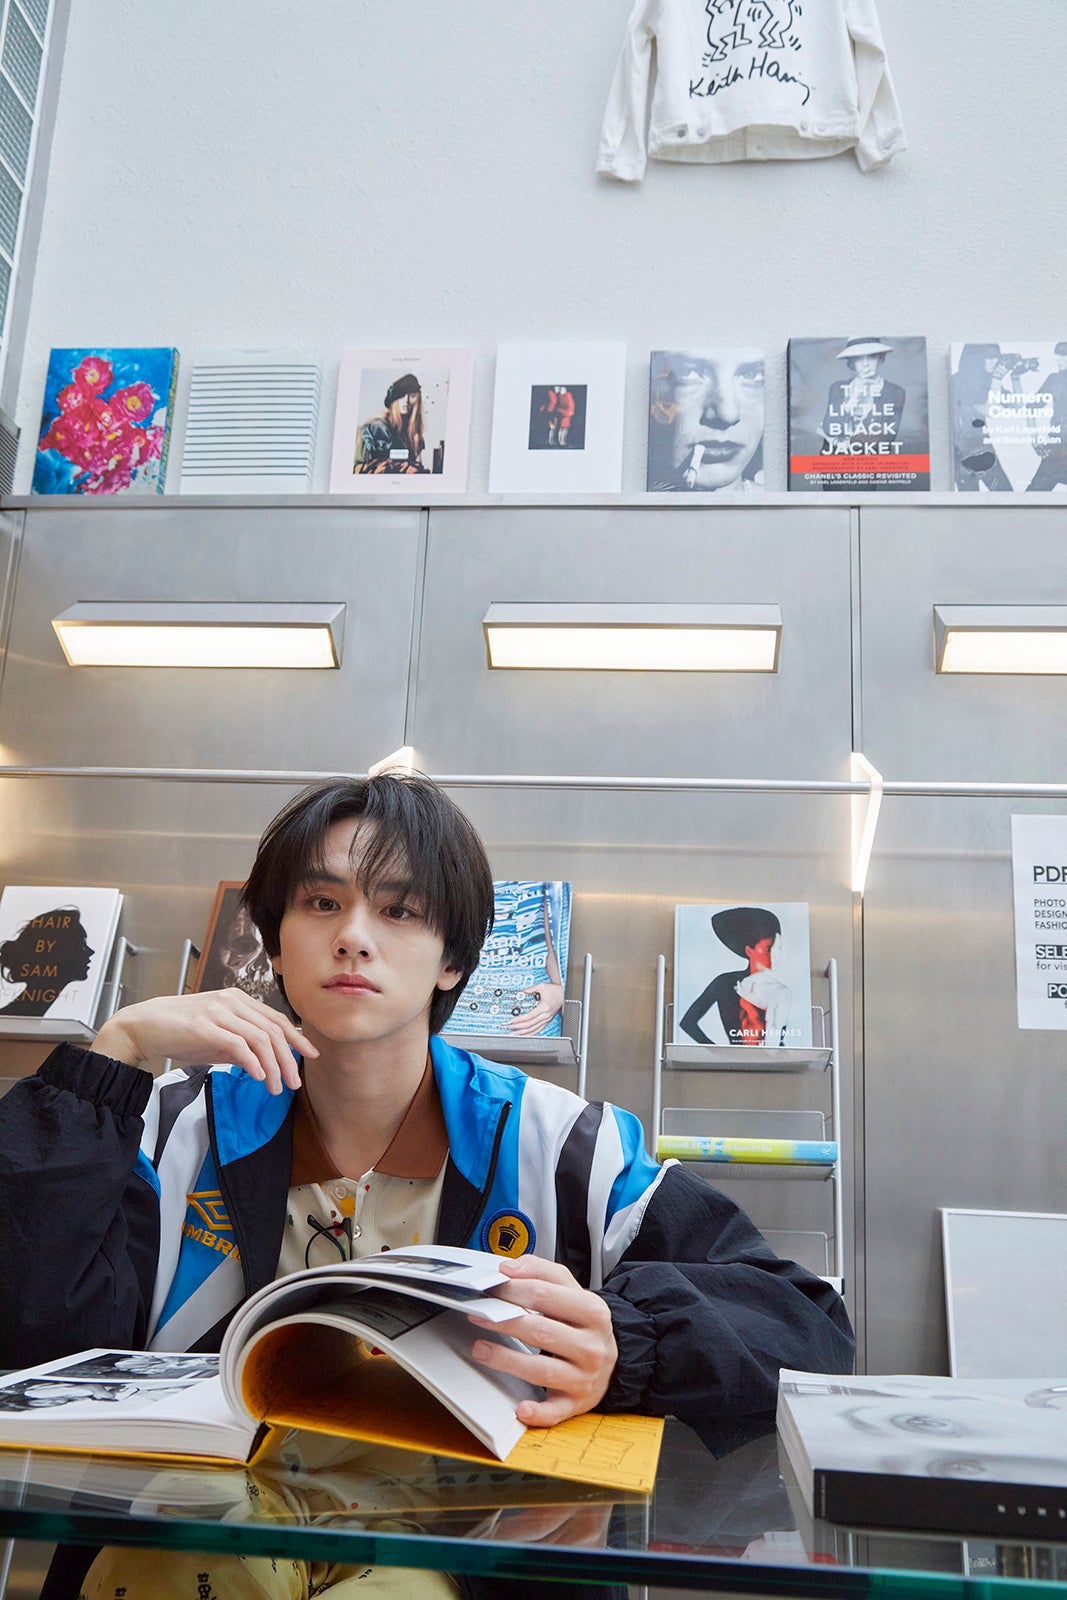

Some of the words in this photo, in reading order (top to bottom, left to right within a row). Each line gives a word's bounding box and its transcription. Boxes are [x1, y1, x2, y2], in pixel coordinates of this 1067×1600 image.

[689, 65, 743, 98] Keith
[840, 385, 882, 397] THE
[829, 403, 895, 417] LITTLE
[988, 405, 1055, 418] Couture
[829, 422, 897, 436] BLACK
[821, 441, 904, 456] JACKET
[1034, 899, 1066, 907] PHOTO
[31, 915, 72, 929] HAIR
[35, 940, 56, 953] BY
[20, 964, 58, 977] SAM
[1036, 961, 1051, 970] for
[729, 1028, 759, 1038] CARLI
